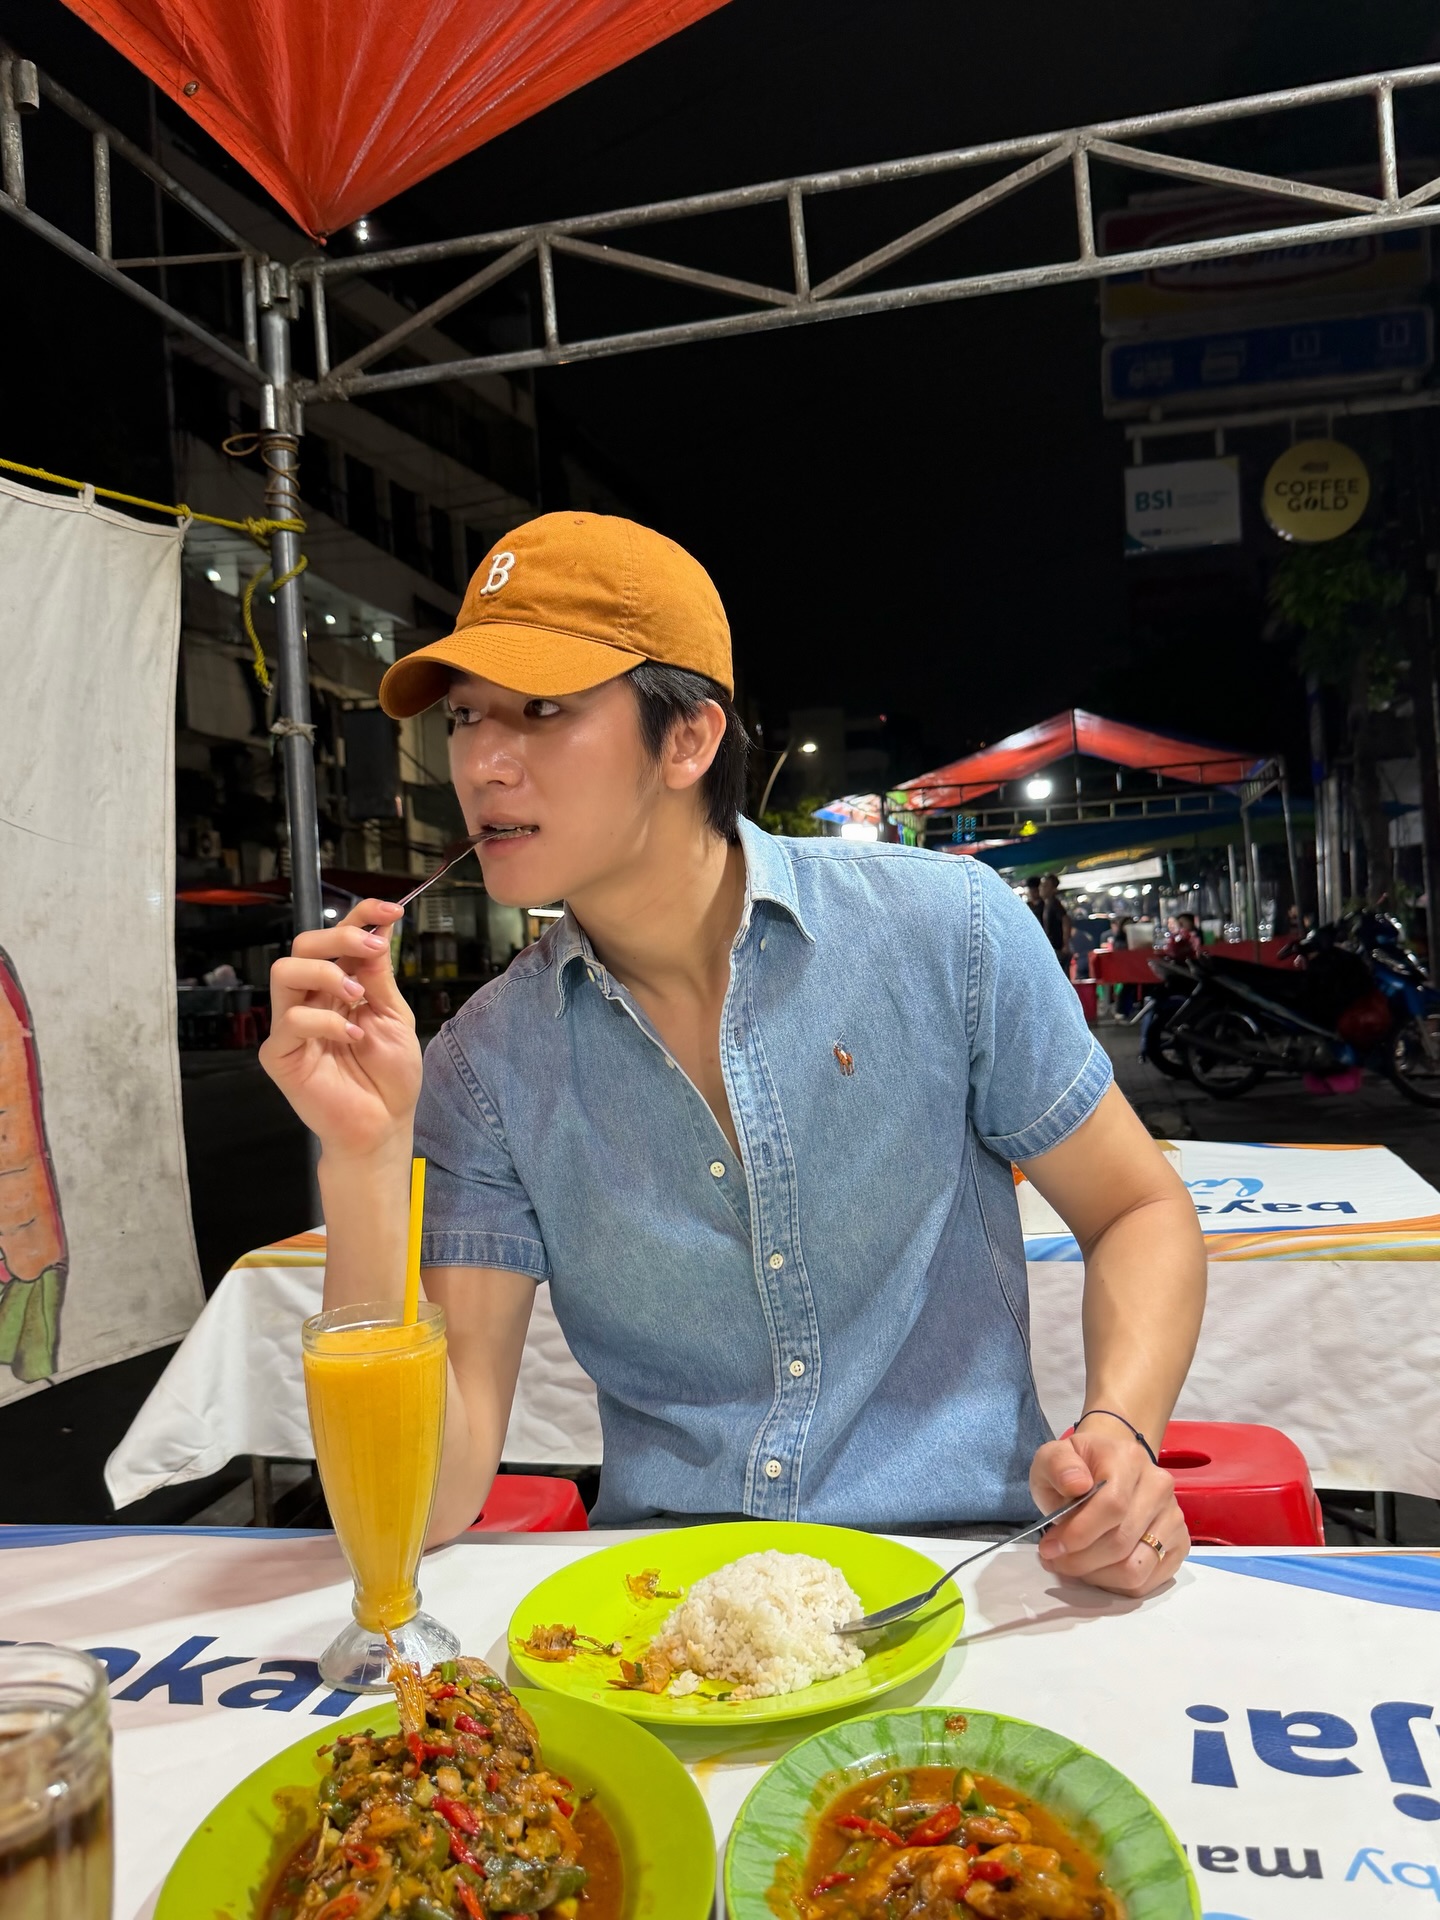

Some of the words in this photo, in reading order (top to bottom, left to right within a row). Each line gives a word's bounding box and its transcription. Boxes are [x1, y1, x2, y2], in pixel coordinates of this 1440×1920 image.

[1134, 489, 1173, 513] BSI
[1274, 478, 1360, 497] COFFEE
[1287, 495, 1349, 512] GOLD
[480, 551, 515, 595] B
[1185, 1701, 1440, 1822] ja!
[1182, 1844, 1324, 1880] ma
